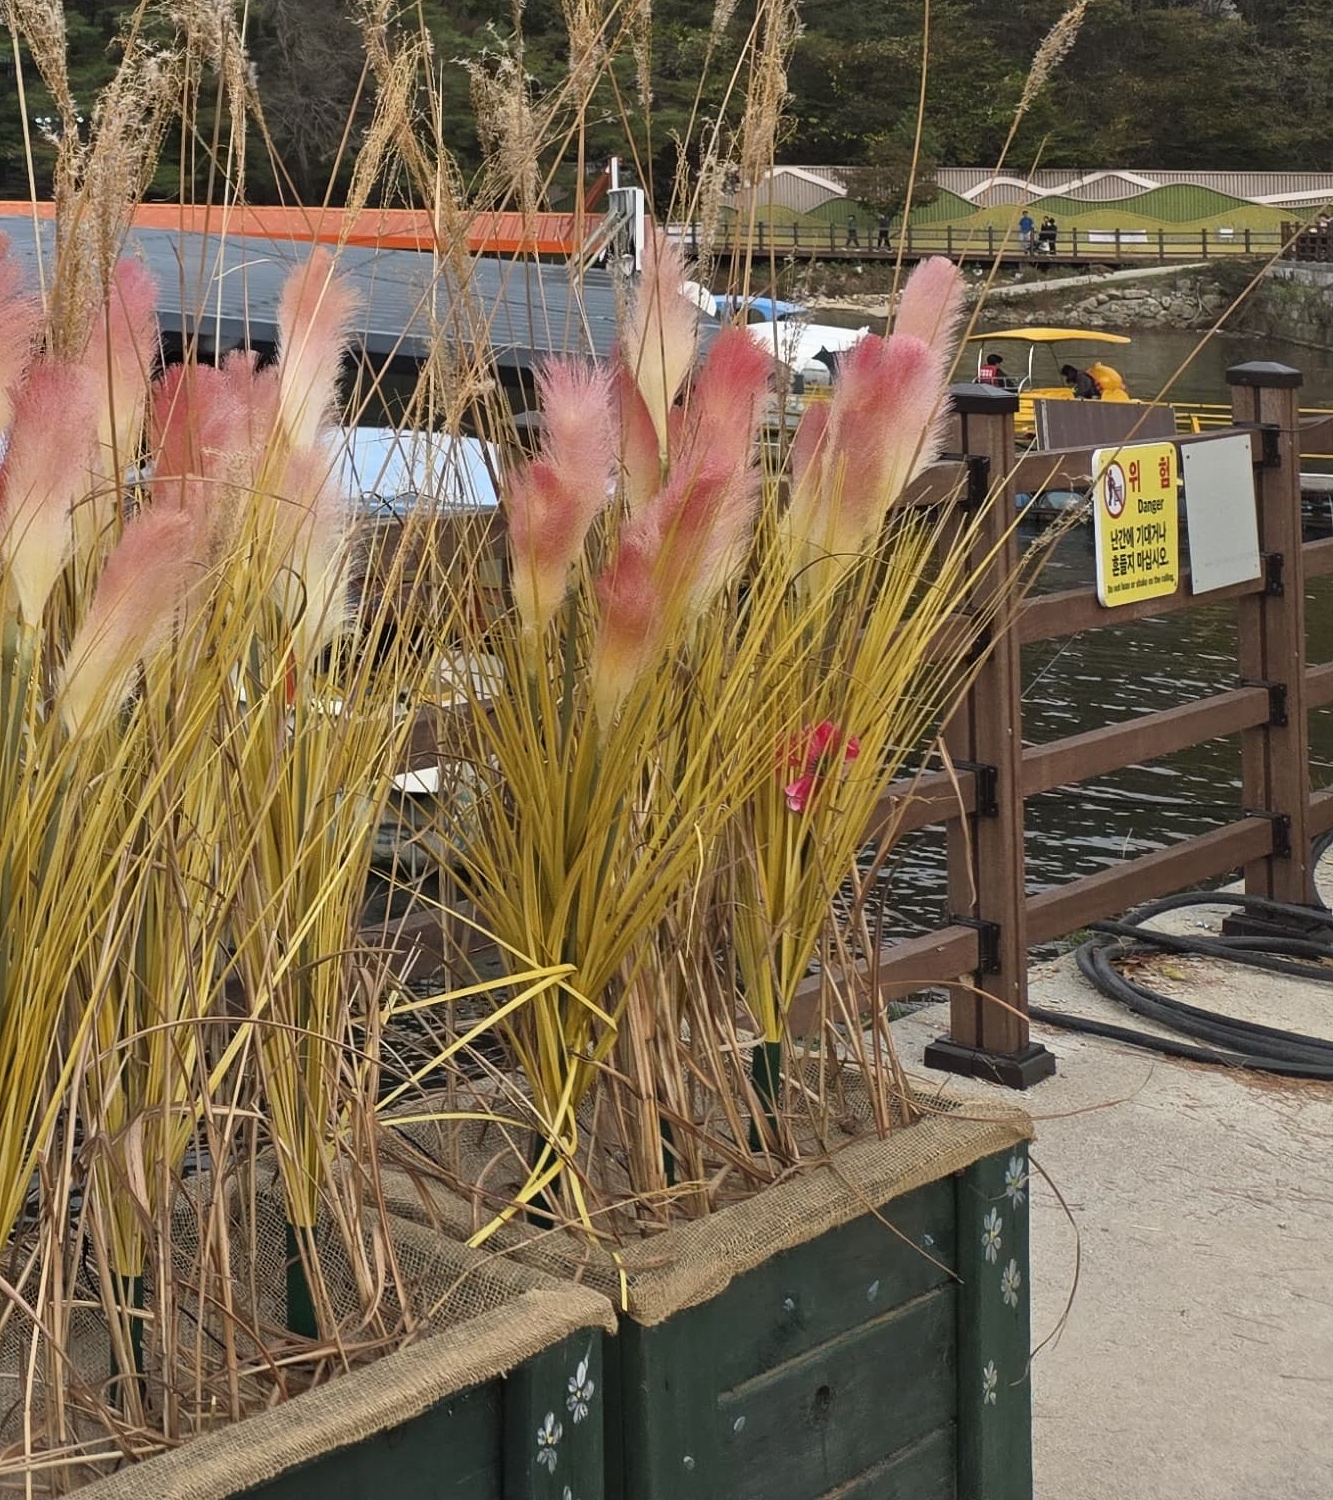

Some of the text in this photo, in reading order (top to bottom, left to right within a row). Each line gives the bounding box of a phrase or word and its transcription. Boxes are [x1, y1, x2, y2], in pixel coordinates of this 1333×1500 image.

[1137, 498, 1164, 514] Danger
[1110, 521, 1167, 551] 난간에 기대거나
[1111, 552, 1135, 577] 흔들지
